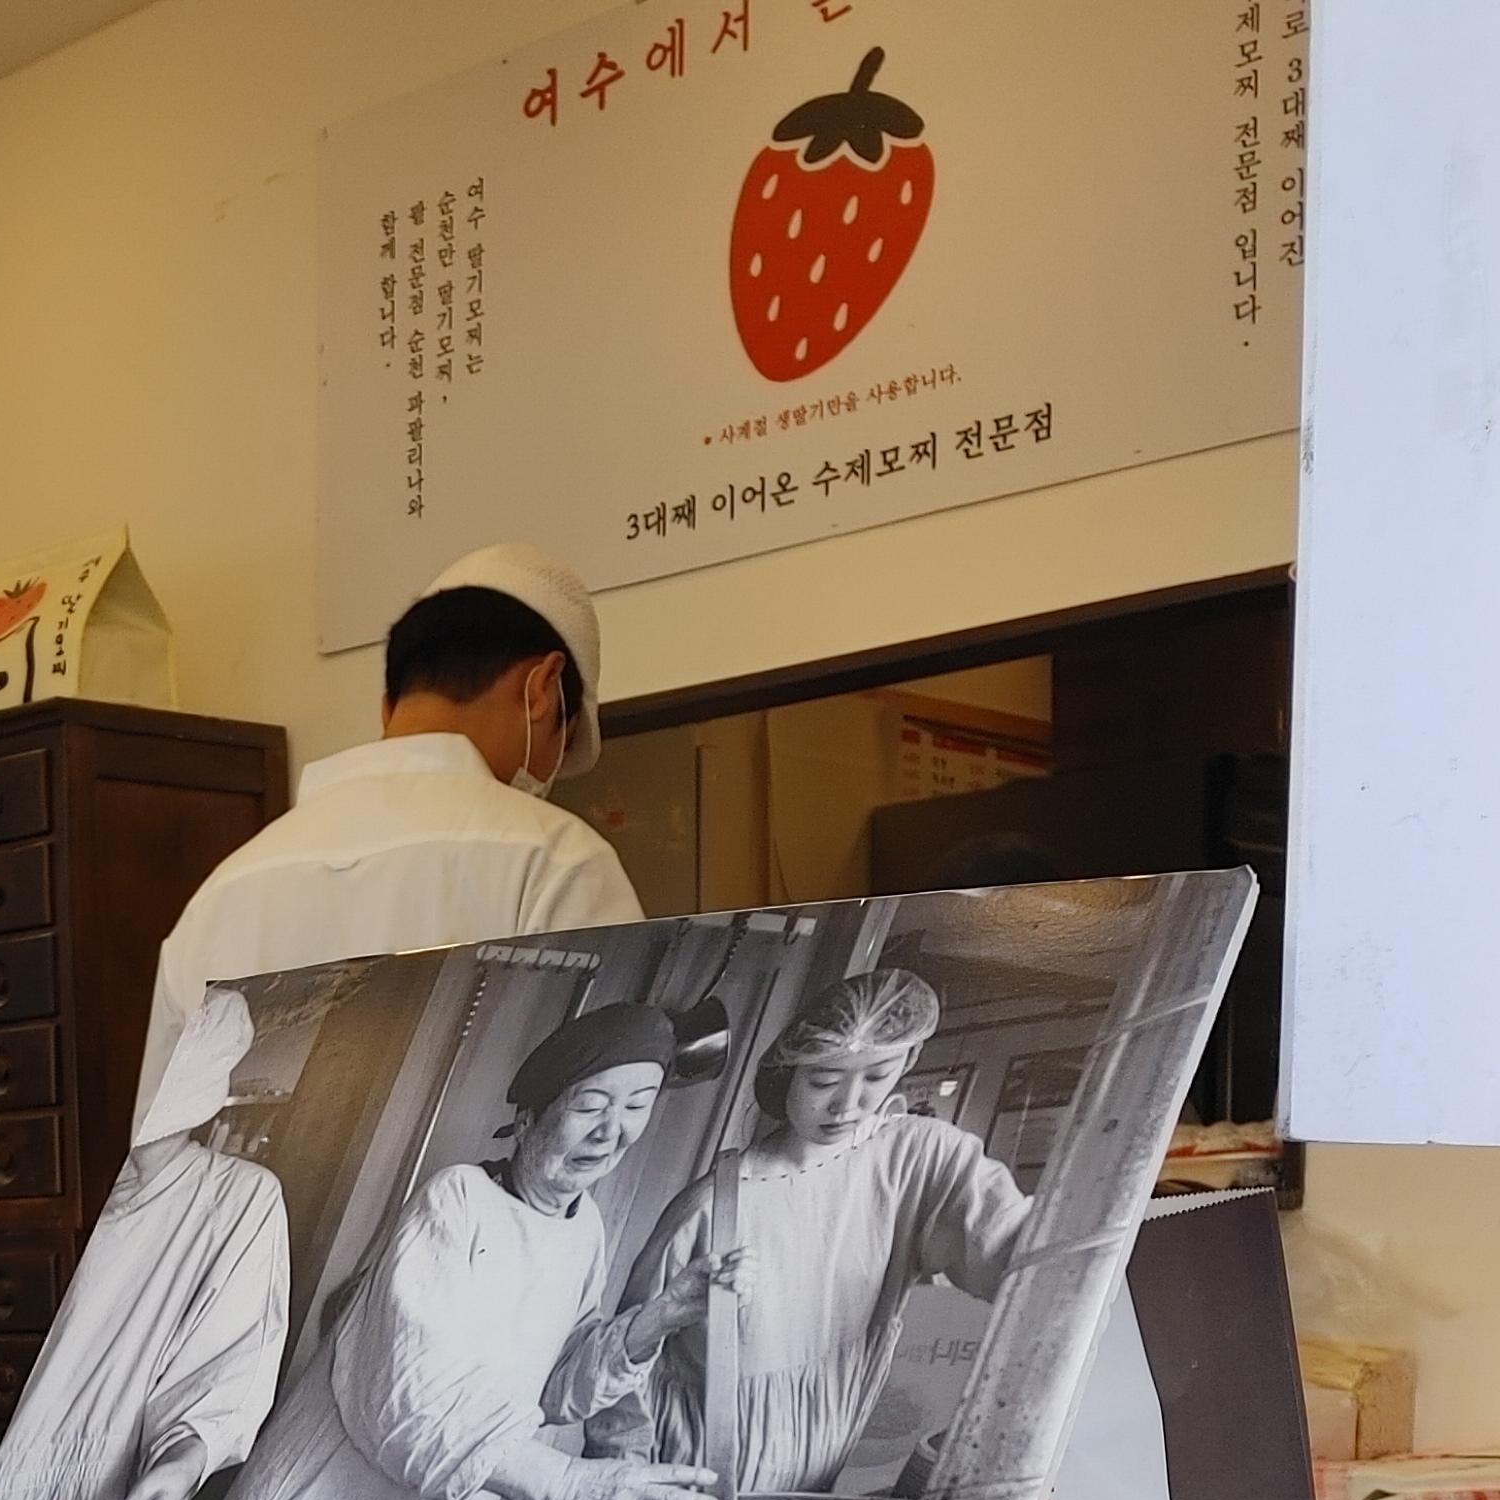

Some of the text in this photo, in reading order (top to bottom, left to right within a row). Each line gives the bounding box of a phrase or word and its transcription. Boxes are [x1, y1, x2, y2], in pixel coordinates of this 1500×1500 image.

[1233, 0, 1263, 347] 제모찌 전문점 입니다.
[1279, 167, 1305, 267] 이어진
[438, 191, 457, 268] 순천만
[465, 177, 486, 375] 여수 딸기모찌는
[408, 329, 426, 379] 순천
[719, 416, 768, 445] 사계절
[867, 363, 962, 404] 사용합니다.
[626, 402, 1053, 541] 3대째 이어온 수제모찌 전문점
